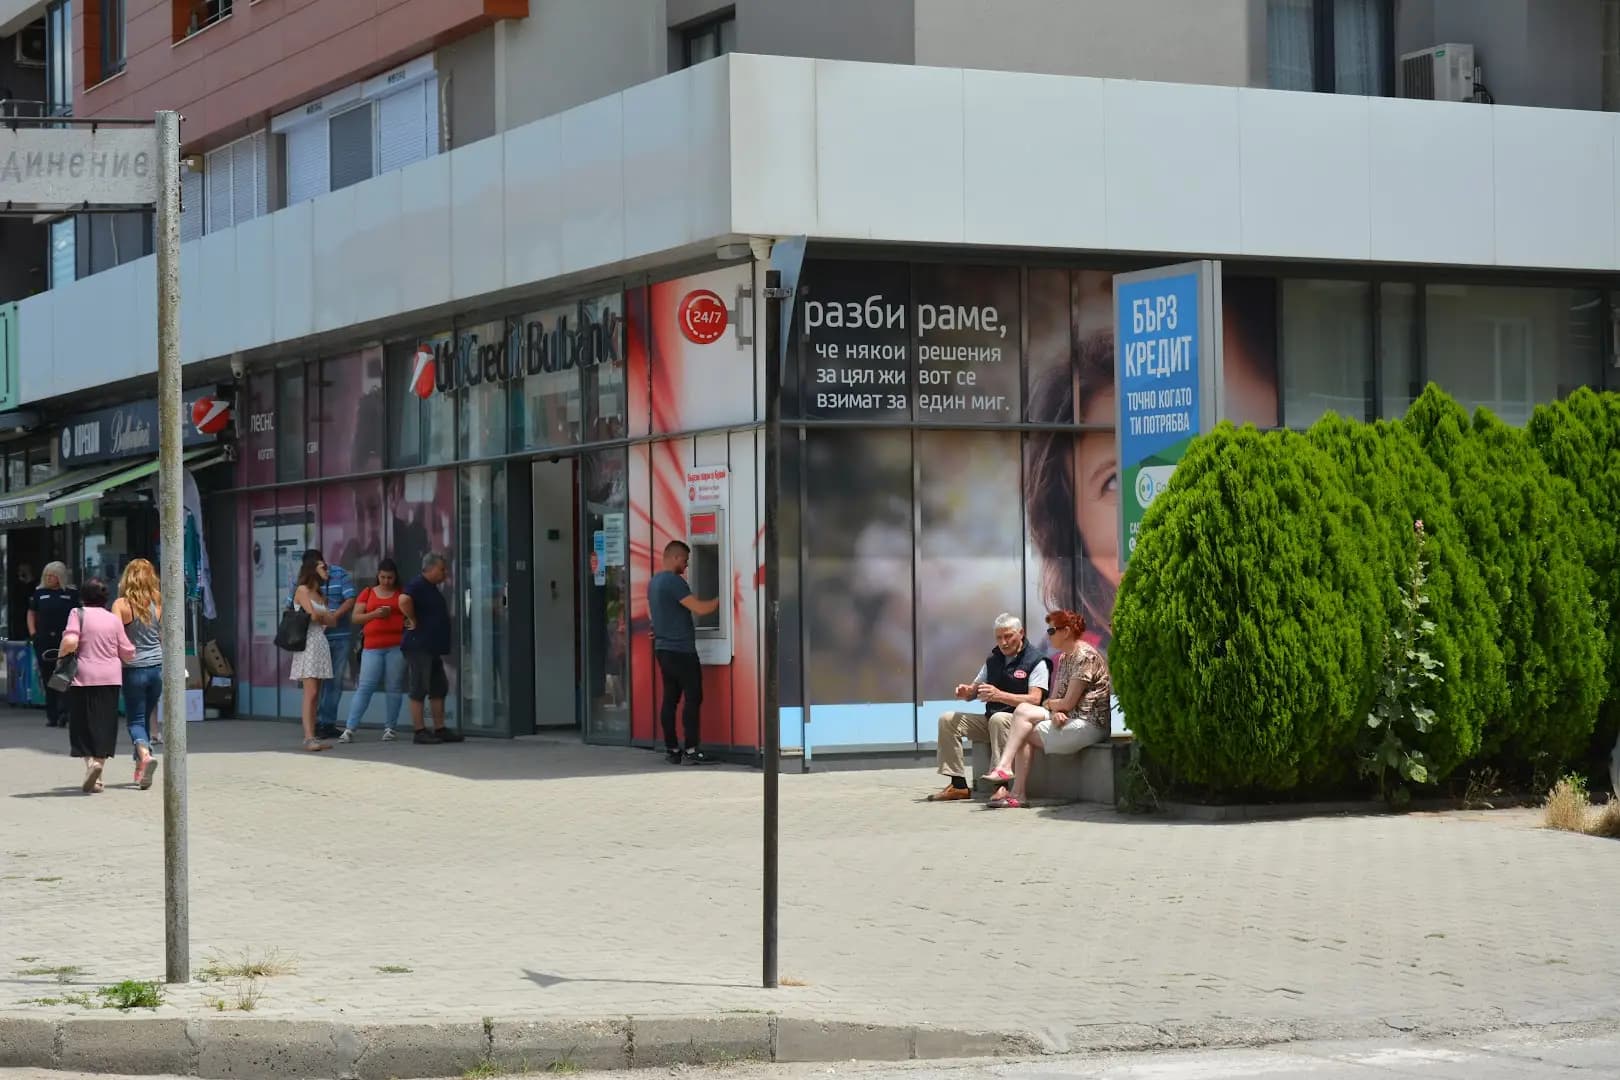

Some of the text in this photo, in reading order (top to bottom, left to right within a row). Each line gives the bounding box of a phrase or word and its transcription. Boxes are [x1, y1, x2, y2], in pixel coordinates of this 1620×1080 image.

[693, 311, 721, 323] 24/7
[1132, 294, 1178, 334] БЪРЗ
[527, 306, 621, 377] Bulbank
[816, 343, 1001, 364] че някои решения
[1125, 336, 1193, 378] КРЕДИТ
[816, 368, 836, 384] за
[841, 369, 874, 387] цял
[956, 371, 976, 385] се
[817, 393, 1009, 413] взимат за един миг.
[1127, 387, 1192, 411] ТОЧНО КОГАТО
[1130, 411, 1190, 436] ТИ ПОТРЯБВА
